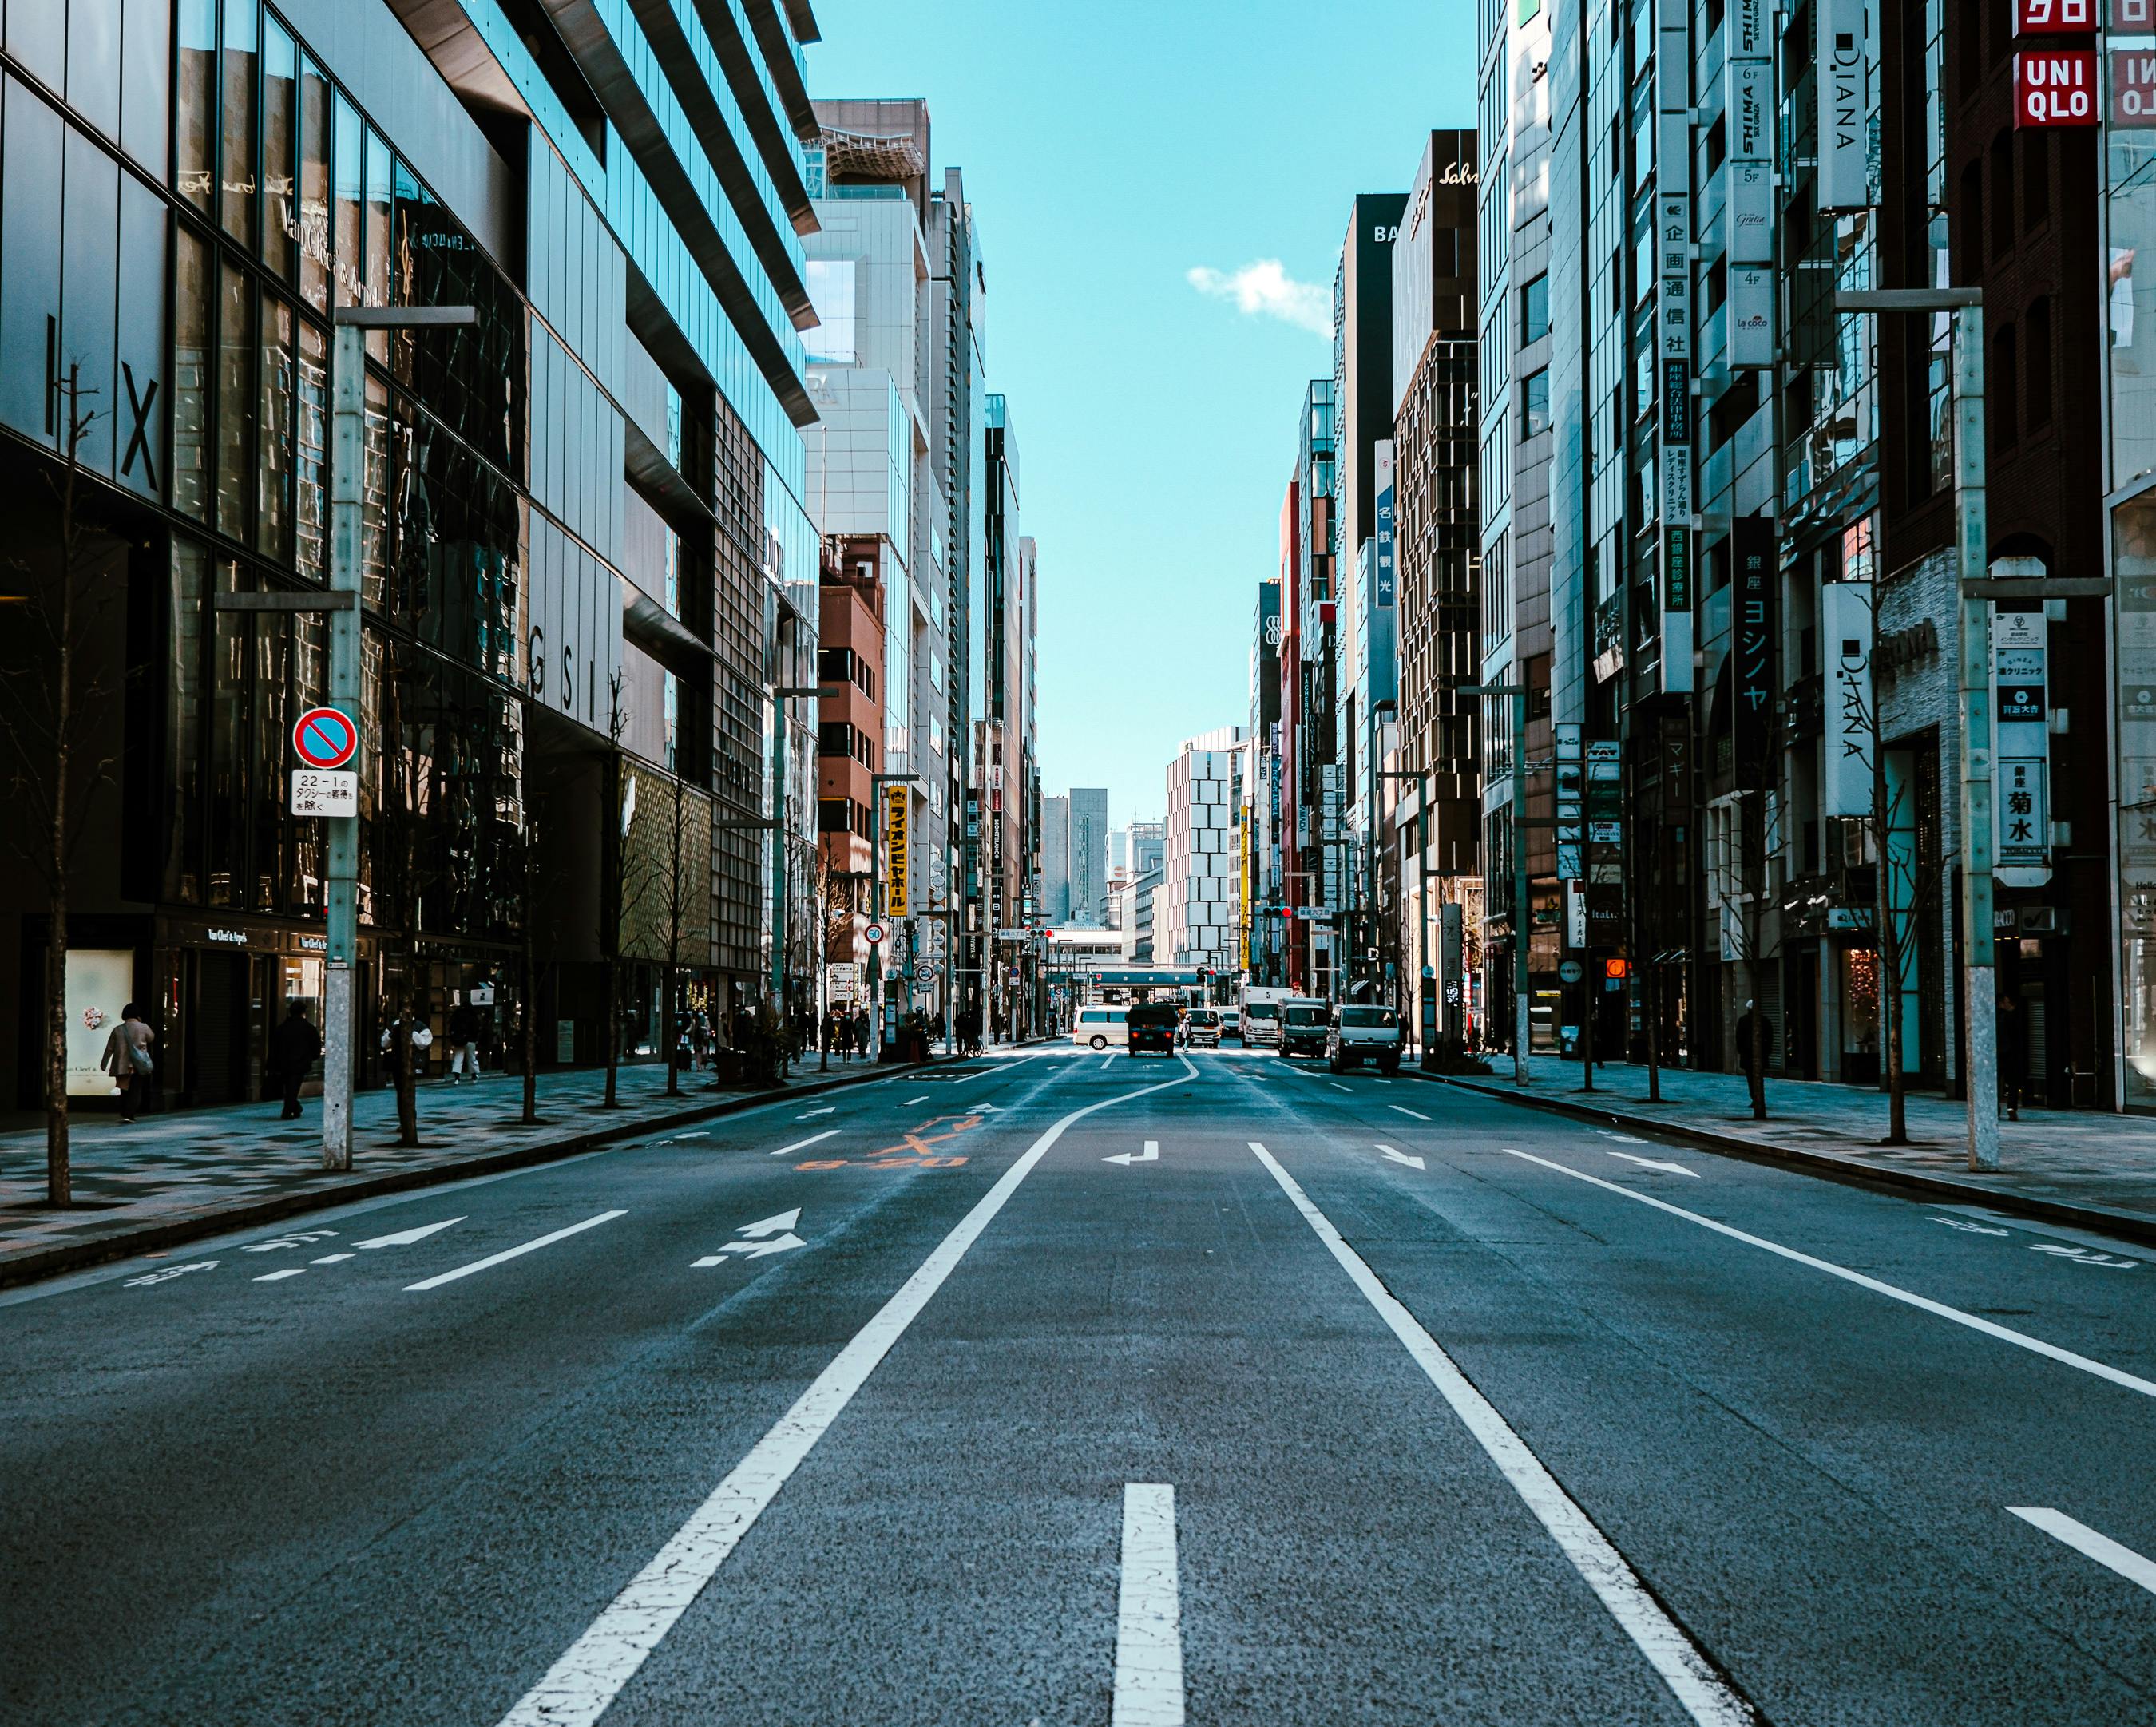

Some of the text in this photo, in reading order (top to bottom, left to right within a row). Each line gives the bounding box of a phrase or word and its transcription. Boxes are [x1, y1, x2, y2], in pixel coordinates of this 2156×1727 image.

[2027, 59, 2083, 86] UNI
[1743, 85, 1754, 155] SHIMA
[1833, 50, 1860, 150] DIANA
[2027, 90, 2089, 122] QLO
[1744, 169, 1759, 183] 5F
[1666, 224, 1685, 352] 企画通信社
[1744, 272, 1760, 285] 4F
[1379, 506, 1392, 592] 名鉄観光
[1671, 530, 1683, 608] 西銀座診療所
[1746, 555, 1762, 590] 銀座
[1742, 601, 1768, 711] ヨシノヤ
[1668, 743, 1685, 798] マギー
[2015, 766, 2026, 787] 銀座
[296, 788, 354, 799] タクシーの客待ち
[296, 800, 324, 811] を除く
[2008, 791, 2033, 842] 菊水
[891, 806, 906, 907] ライオンビヤホール
[869, 929, 880, 939] 50
